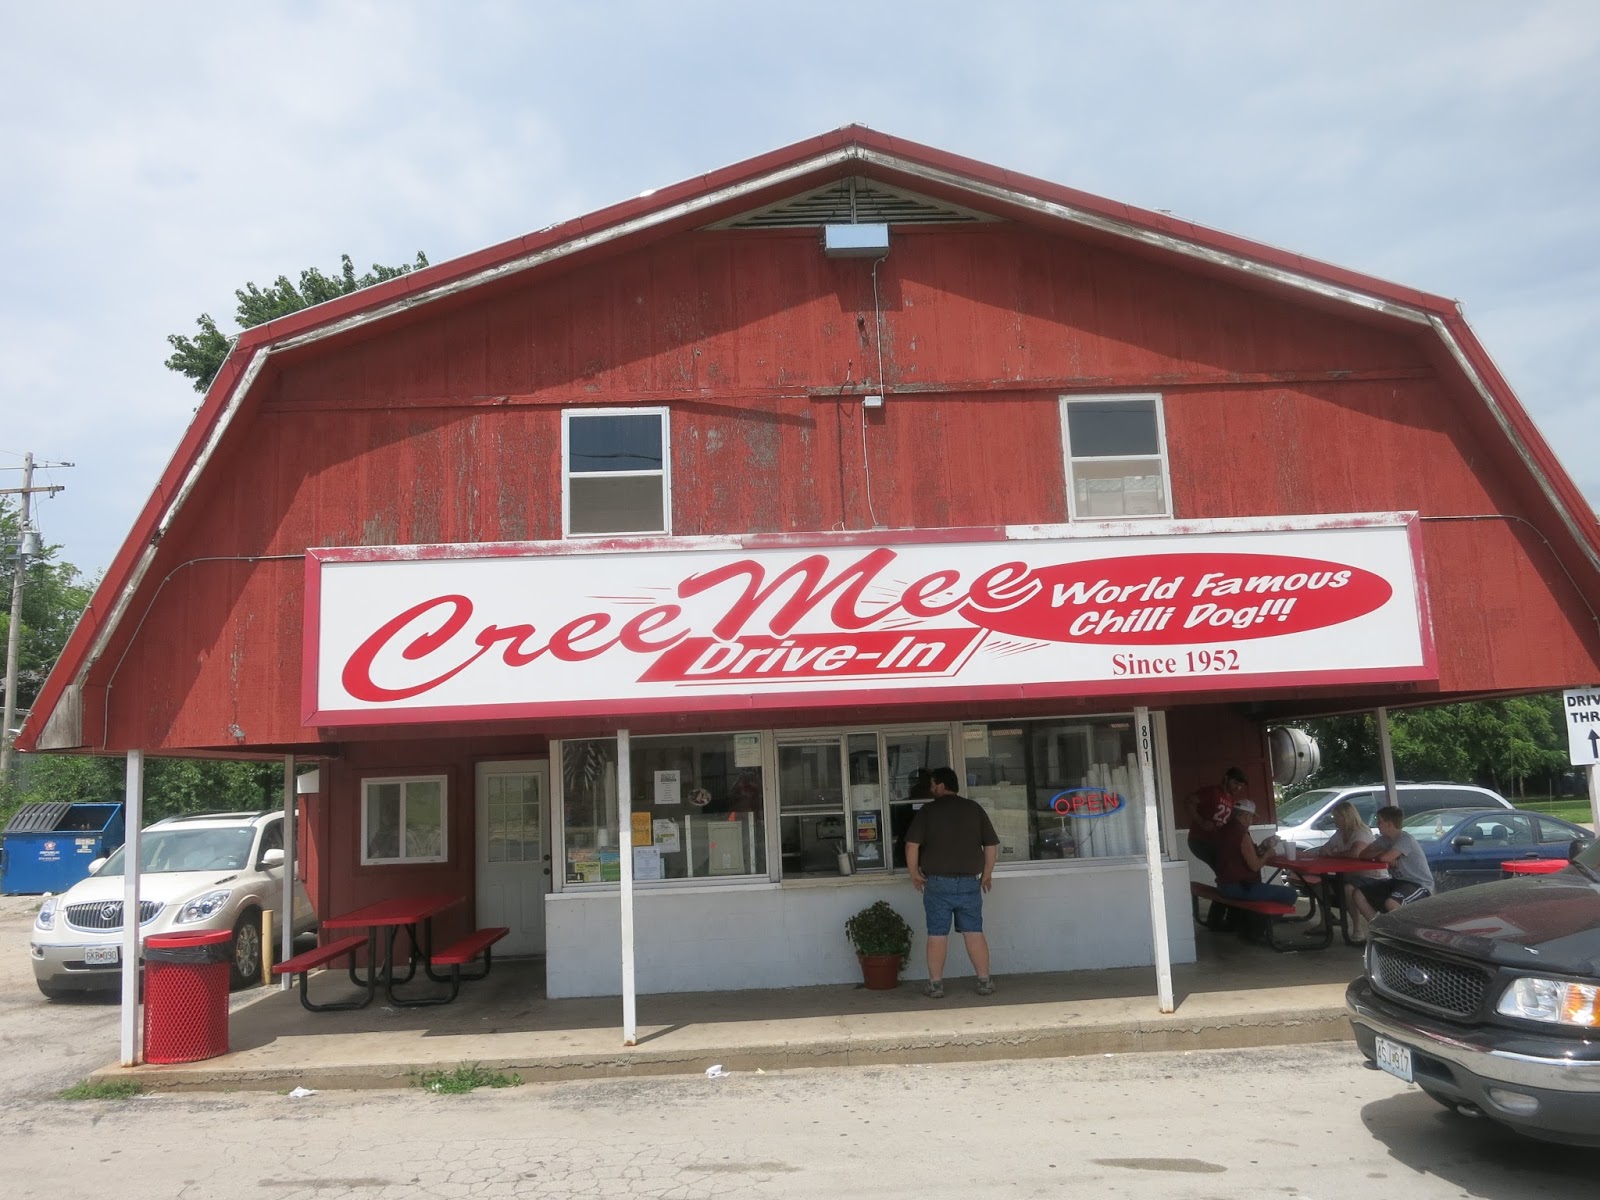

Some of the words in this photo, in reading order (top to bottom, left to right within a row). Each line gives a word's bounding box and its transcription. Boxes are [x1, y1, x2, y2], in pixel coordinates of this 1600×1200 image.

[1050, 576, 1184, 607] World
[1191, 570, 1352, 597] Famous
[1069, 606, 1176, 636] Chilli
[1183, 597, 1298, 629] Dog!!!
[684, 635, 947, 676] Drive-In
[1112, 652, 1177, 676] Since
[1186, 649, 1240, 673] 1952
[1141, 725, 1149, 763] 801
[1054, 792, 1119, 816] OPEN
